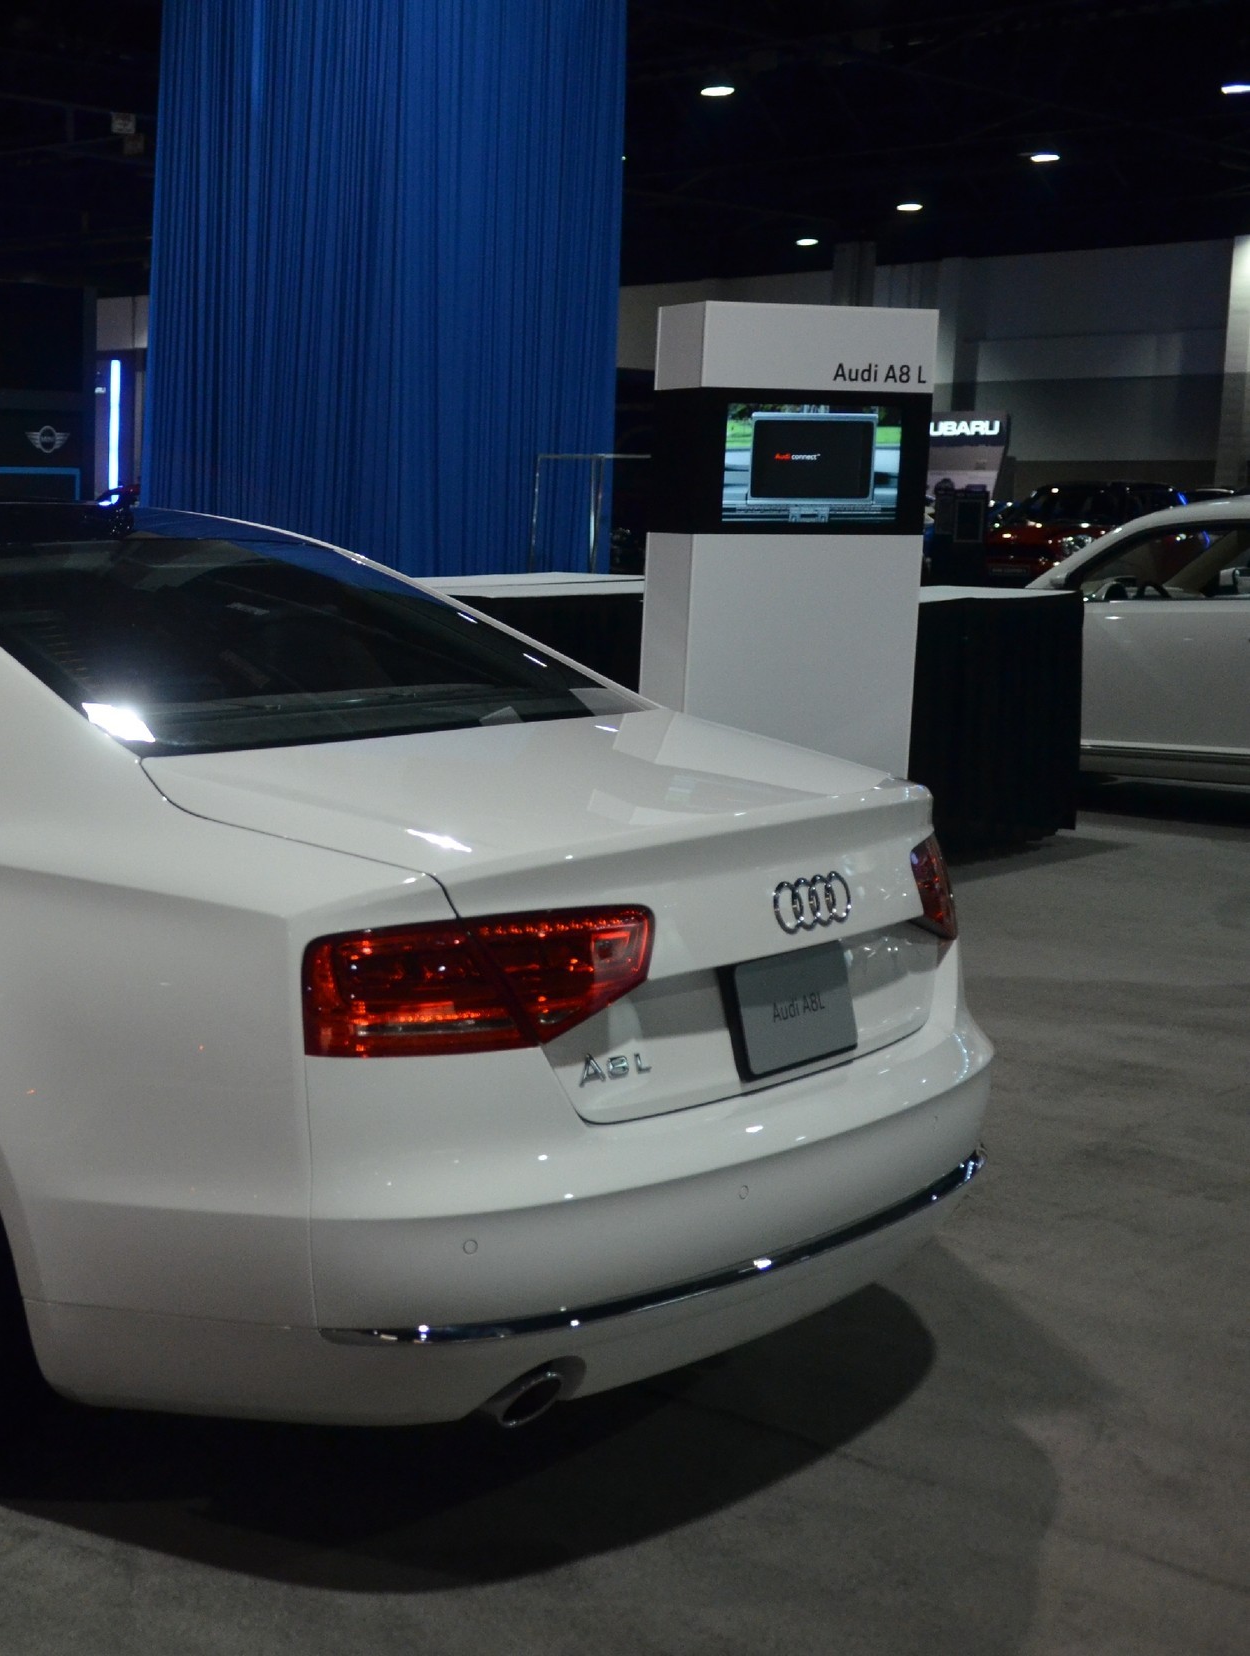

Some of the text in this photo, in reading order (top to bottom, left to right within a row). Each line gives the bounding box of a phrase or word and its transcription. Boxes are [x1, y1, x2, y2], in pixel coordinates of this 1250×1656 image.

[833, 362, 927, 384] Audi A8 L
[929, 420, 1000, 436] UBARU
[772, 1000, 800, 1023] Audi
